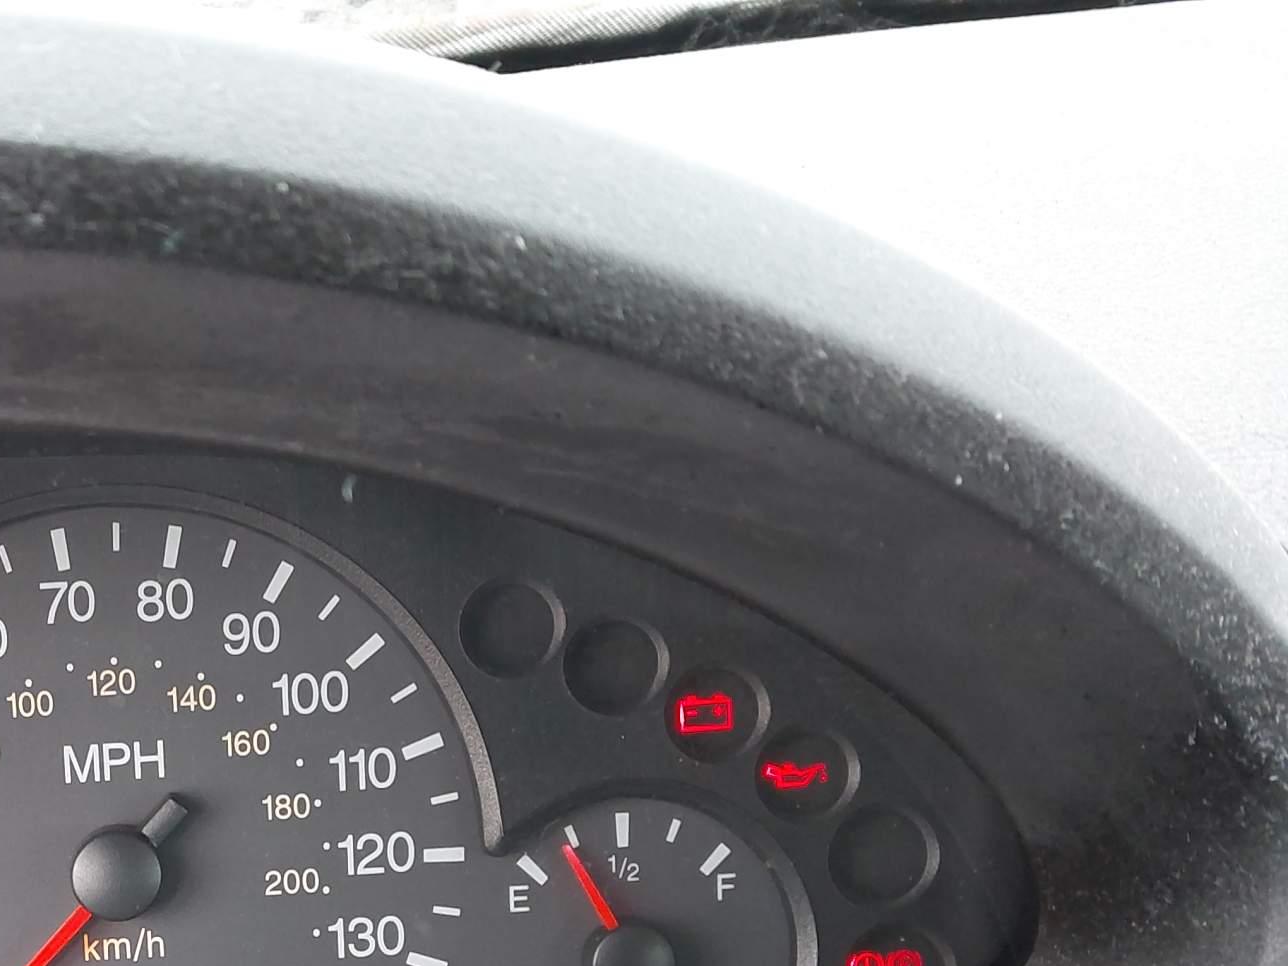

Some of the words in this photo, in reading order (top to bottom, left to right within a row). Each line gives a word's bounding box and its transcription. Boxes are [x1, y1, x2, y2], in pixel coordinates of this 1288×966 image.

[39, 579, 96, 625] 70
[136, 578, 194, 622] 80
[222, 610, 281, 656] 90
[86, 668, 136, 697] 120
[166, 684, 216, 712] 140
[272, 670, 350, 716] 100
[6, 690, 54, 718] 100
[221, 729, 270, 758] 160
[62, 738, 165, 785] MPH
[328, 747, 397, 792] 110
[262, 793, 311, 821] 180
[337, 831, 416, 876] 120
[607, 855, 640, 882] 1/2
[264, 868, 320, 896] 200
[717, 873, 736, 901] F
[509, 885, 530, 913] E
[83, 928, 165, 962] km/h
[328, 915, 405, 959] 130
